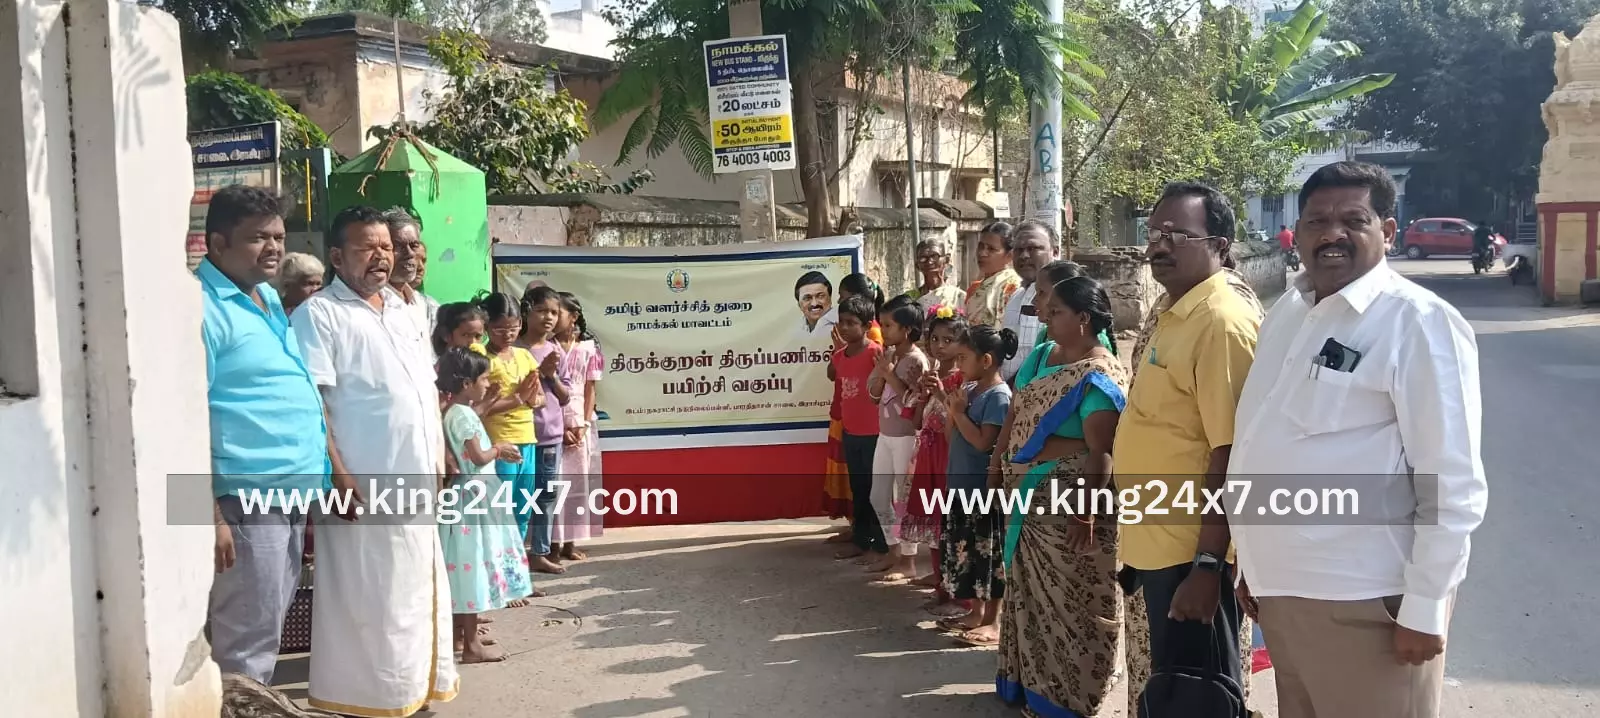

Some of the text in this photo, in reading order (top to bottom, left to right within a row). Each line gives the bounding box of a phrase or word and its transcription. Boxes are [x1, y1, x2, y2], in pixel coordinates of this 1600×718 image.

[711, 41, 779, 58] நாமக்கல்
[741, 98, 781, 111] லட்சம்
[742, 122, 782, 135] ஆயிரம்
[717, 150, 791, 168] 76 4003 4003
[604, 300, 753, 316] தமிழ் வளர்ச்சித் துறை
[626, 317, 732, 332] நாமக்கல் மாவட்டம்
[609, 350, 714, 374] திருக்குறள்
[662, 373, 793, 398] பயிற்சி வகுப்பு
